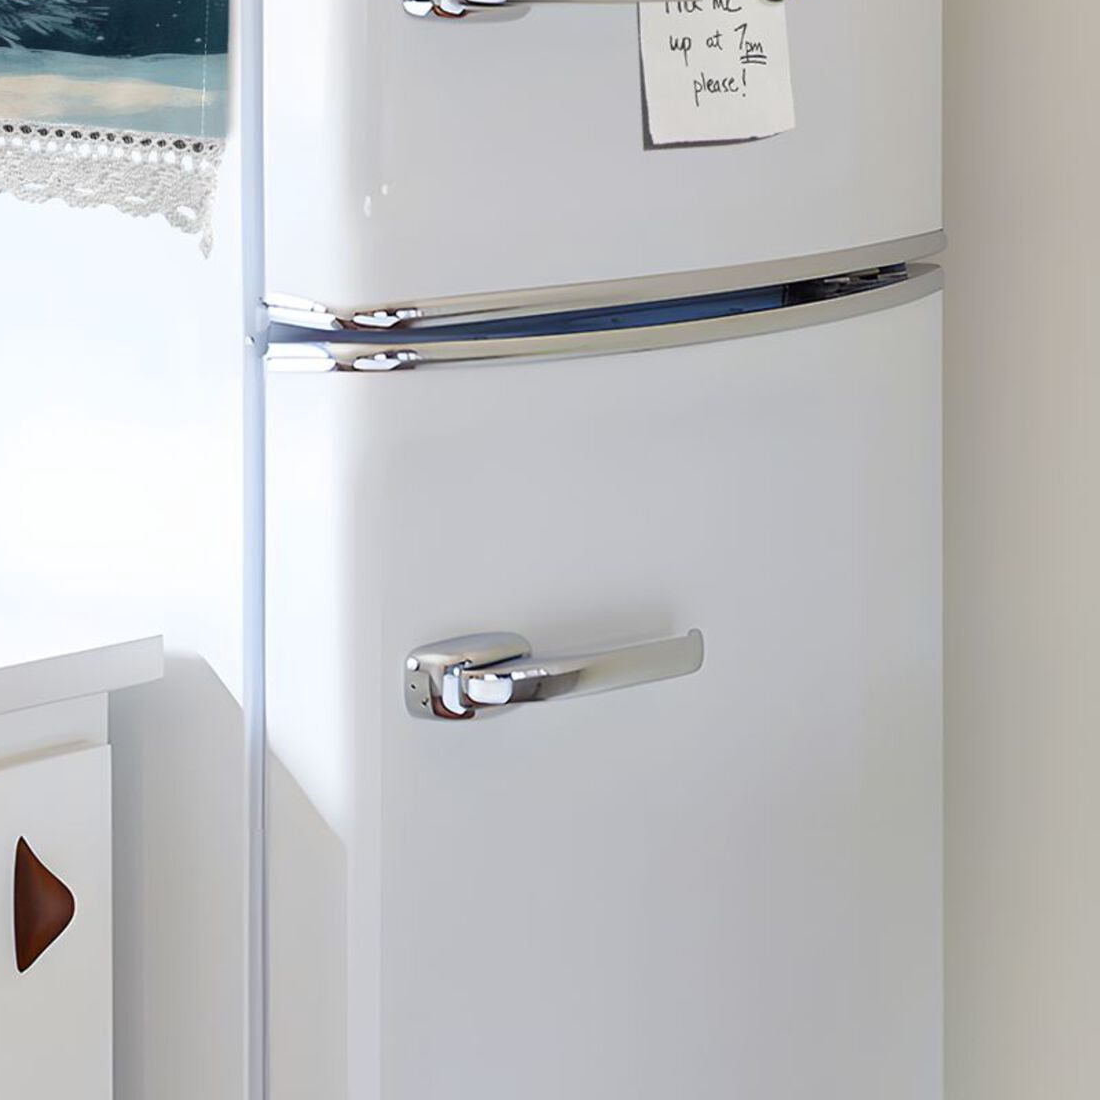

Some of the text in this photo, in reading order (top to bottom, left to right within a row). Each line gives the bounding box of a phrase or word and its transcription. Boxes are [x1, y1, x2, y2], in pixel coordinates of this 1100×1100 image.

[669, 35, 692, 66] up
[706, 30, 723, 51] at
[694, 68, 747, 107] please!
